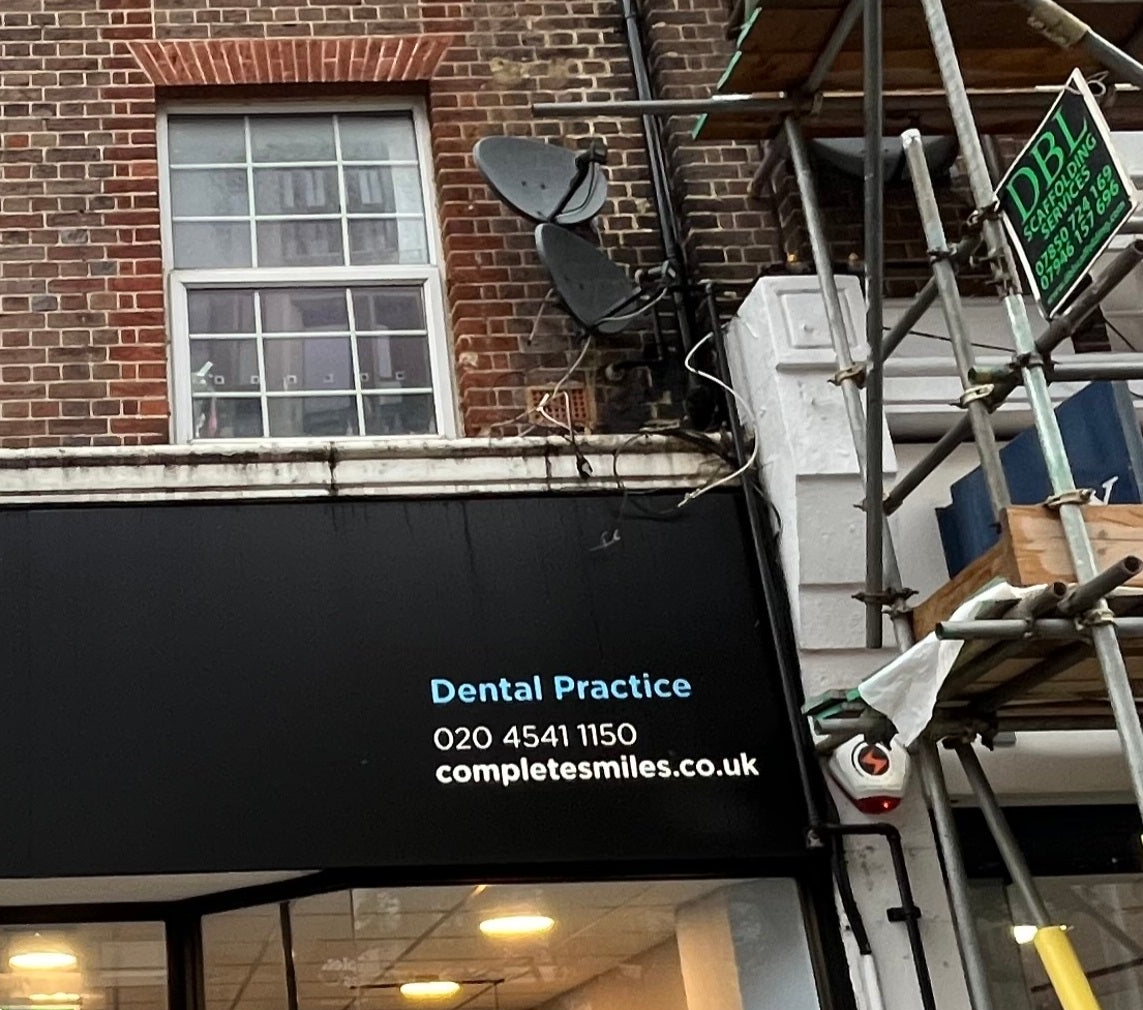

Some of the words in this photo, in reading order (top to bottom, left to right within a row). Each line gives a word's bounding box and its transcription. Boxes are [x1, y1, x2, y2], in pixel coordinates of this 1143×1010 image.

[1006, 105, 1088, 226] DBL
[1023, 133, 1098, 242] SCAFFOLDING
[1040, 164, 1091, 241] SERVICES
[1035, 226, 1069, 277] 07850
[1067, 195, 1091, 231] 724
[1089, 164, 1113, 199] 169
[1040, 243, 1075, 291] 07946
[1074, 210, 1095, 245] 157
[1095, 181, 1120, 217] 696
[430, 675, 543, 704] Dental
[554, 673, 692, 700] Practice
[433, 725, 493, 751] 020
[502, 724, 569, 749] 4541
[577, 722, 637, 747] 1150
[435, 752, 760, 787] completesmiles.co.uk
